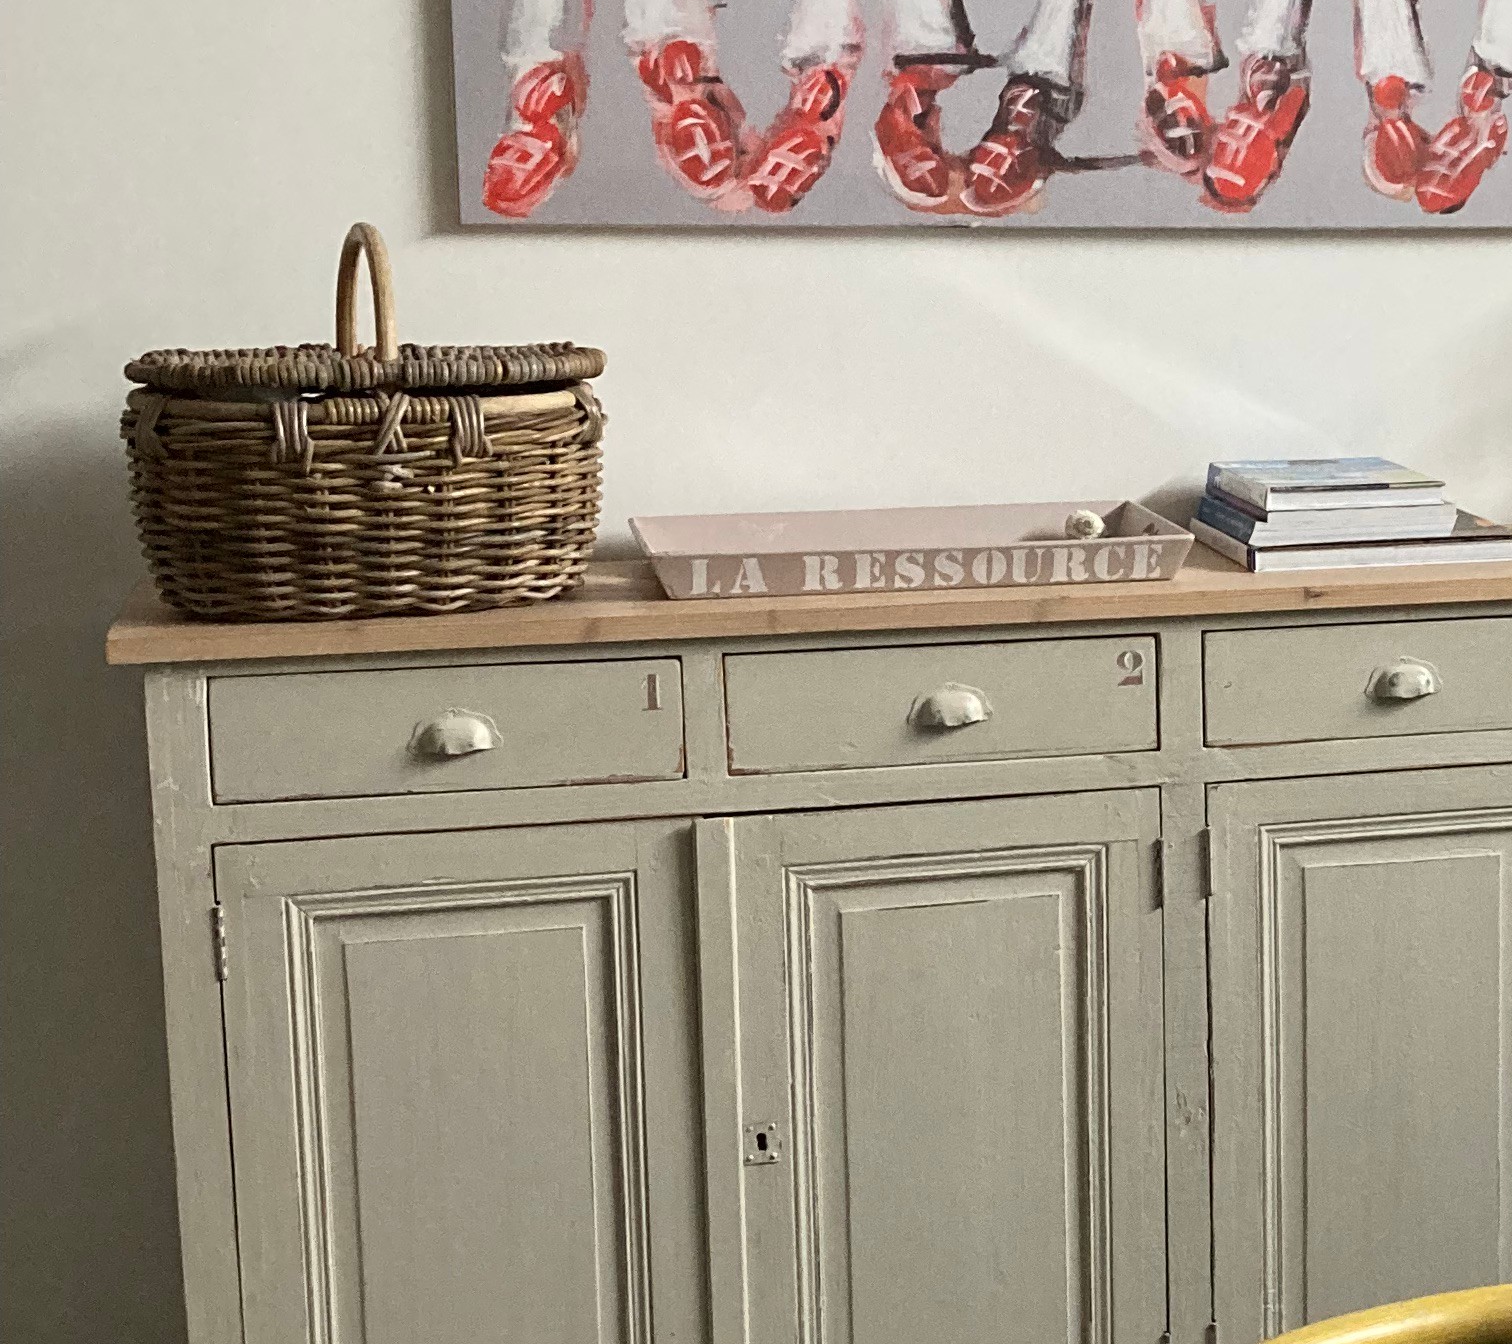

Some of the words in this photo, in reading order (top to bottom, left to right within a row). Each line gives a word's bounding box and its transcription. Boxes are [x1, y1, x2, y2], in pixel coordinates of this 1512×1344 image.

[690, 556, 770, 596] LA
[802, 543, 1164, 593] RESSOURCE
[1116, 649, 1145, 687] 2
[641, 673, 664, 712] 1
